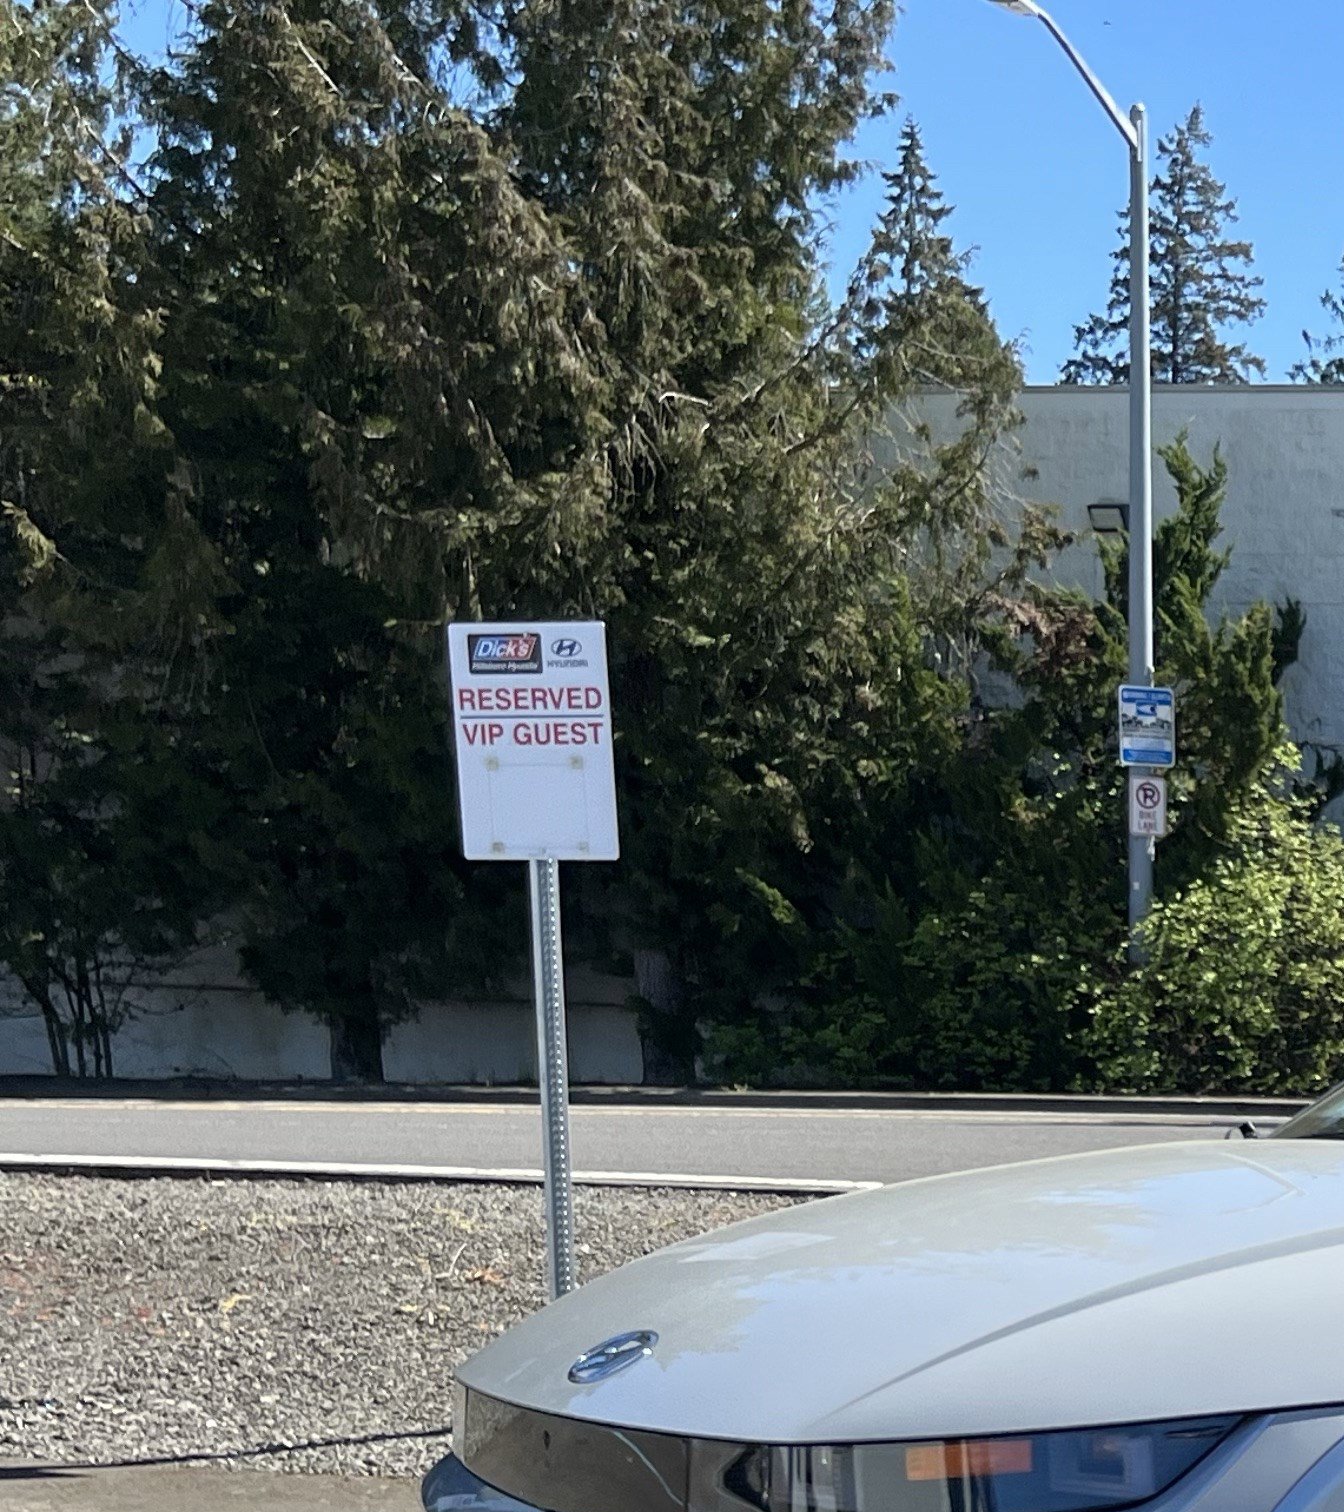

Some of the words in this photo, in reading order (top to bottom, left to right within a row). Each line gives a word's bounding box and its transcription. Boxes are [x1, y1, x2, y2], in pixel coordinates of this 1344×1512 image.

[459, 687, 602, 711] RESERVED
[462, 723, 504, 746] VIP
[512, 721, 604, 746] GUEST
